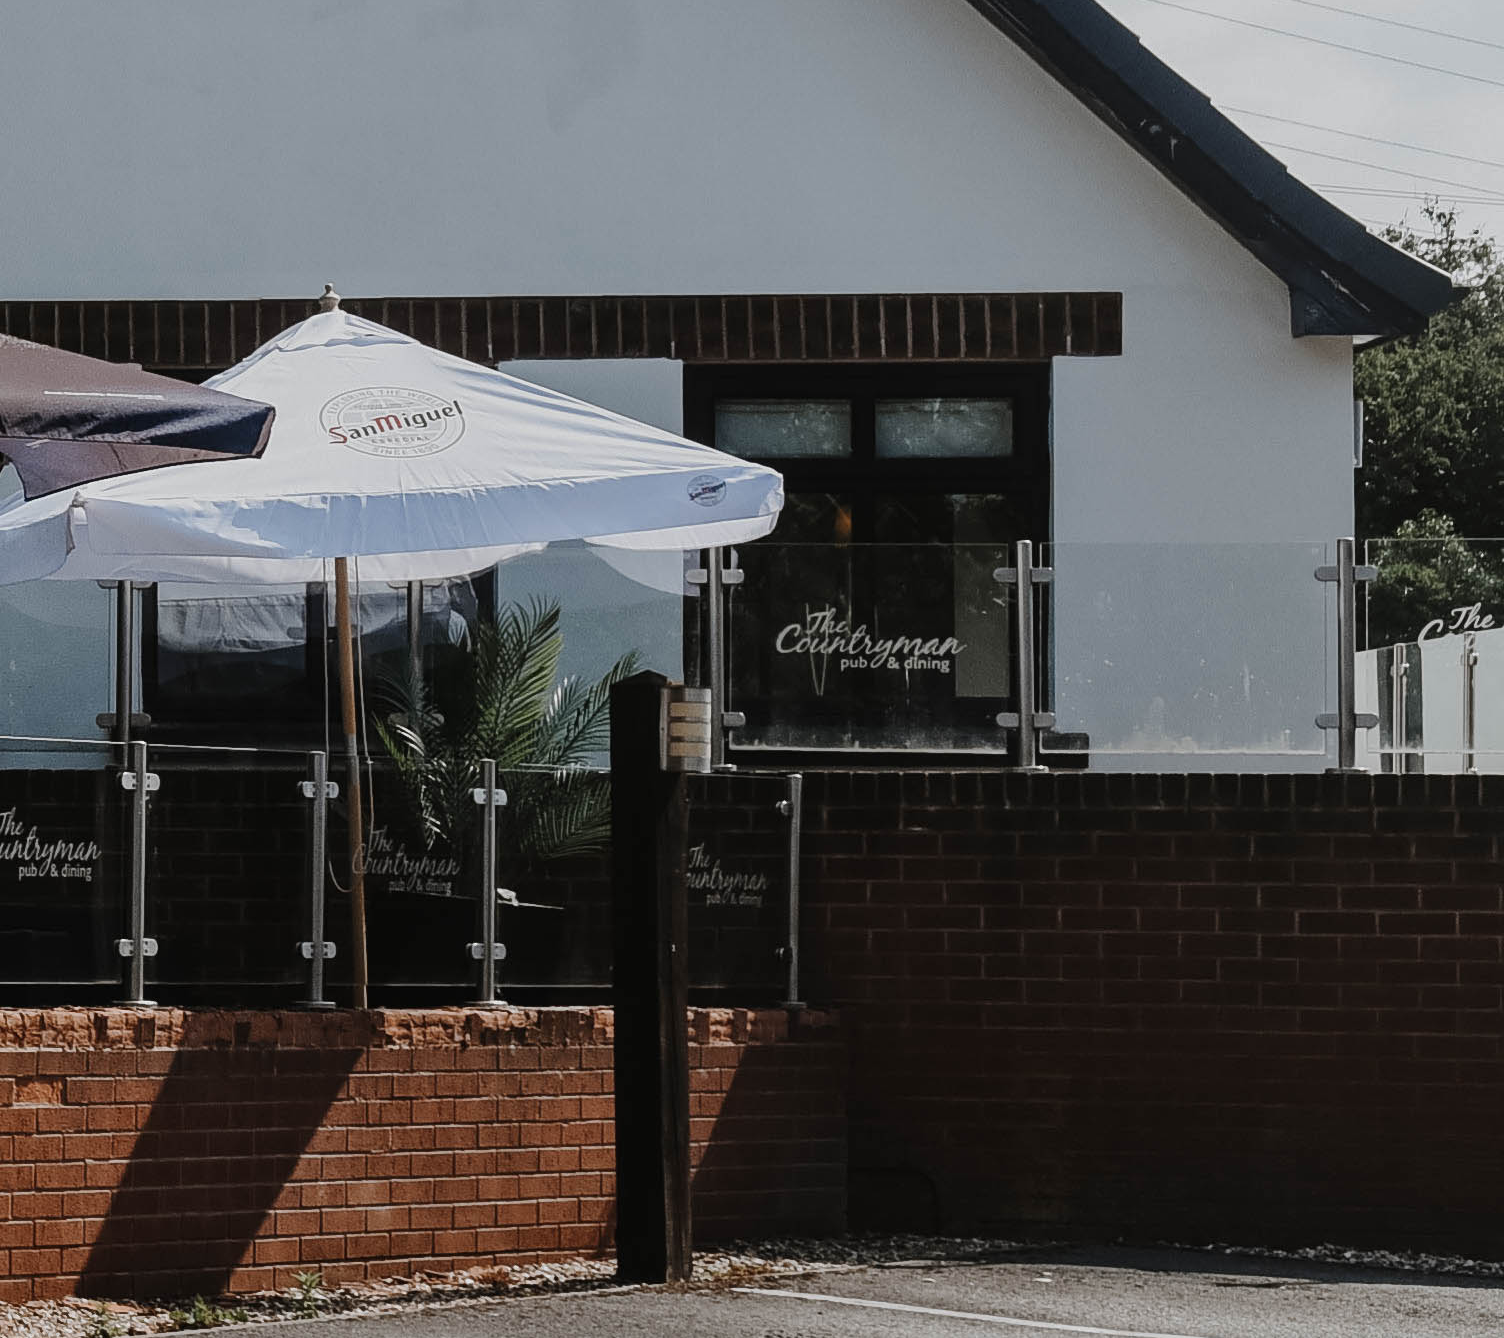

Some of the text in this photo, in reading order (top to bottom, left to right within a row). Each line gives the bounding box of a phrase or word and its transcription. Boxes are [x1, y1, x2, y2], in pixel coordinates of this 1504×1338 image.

[807, 607, 849, 634] The
[1448, 602, 1496, 630] The
[776, 624, 968, 668] Countryman
[841, 656, 950, 674] pub & dining
[689, 842, 711, 869] The
[18, 862, 93, 882] pub & dining
